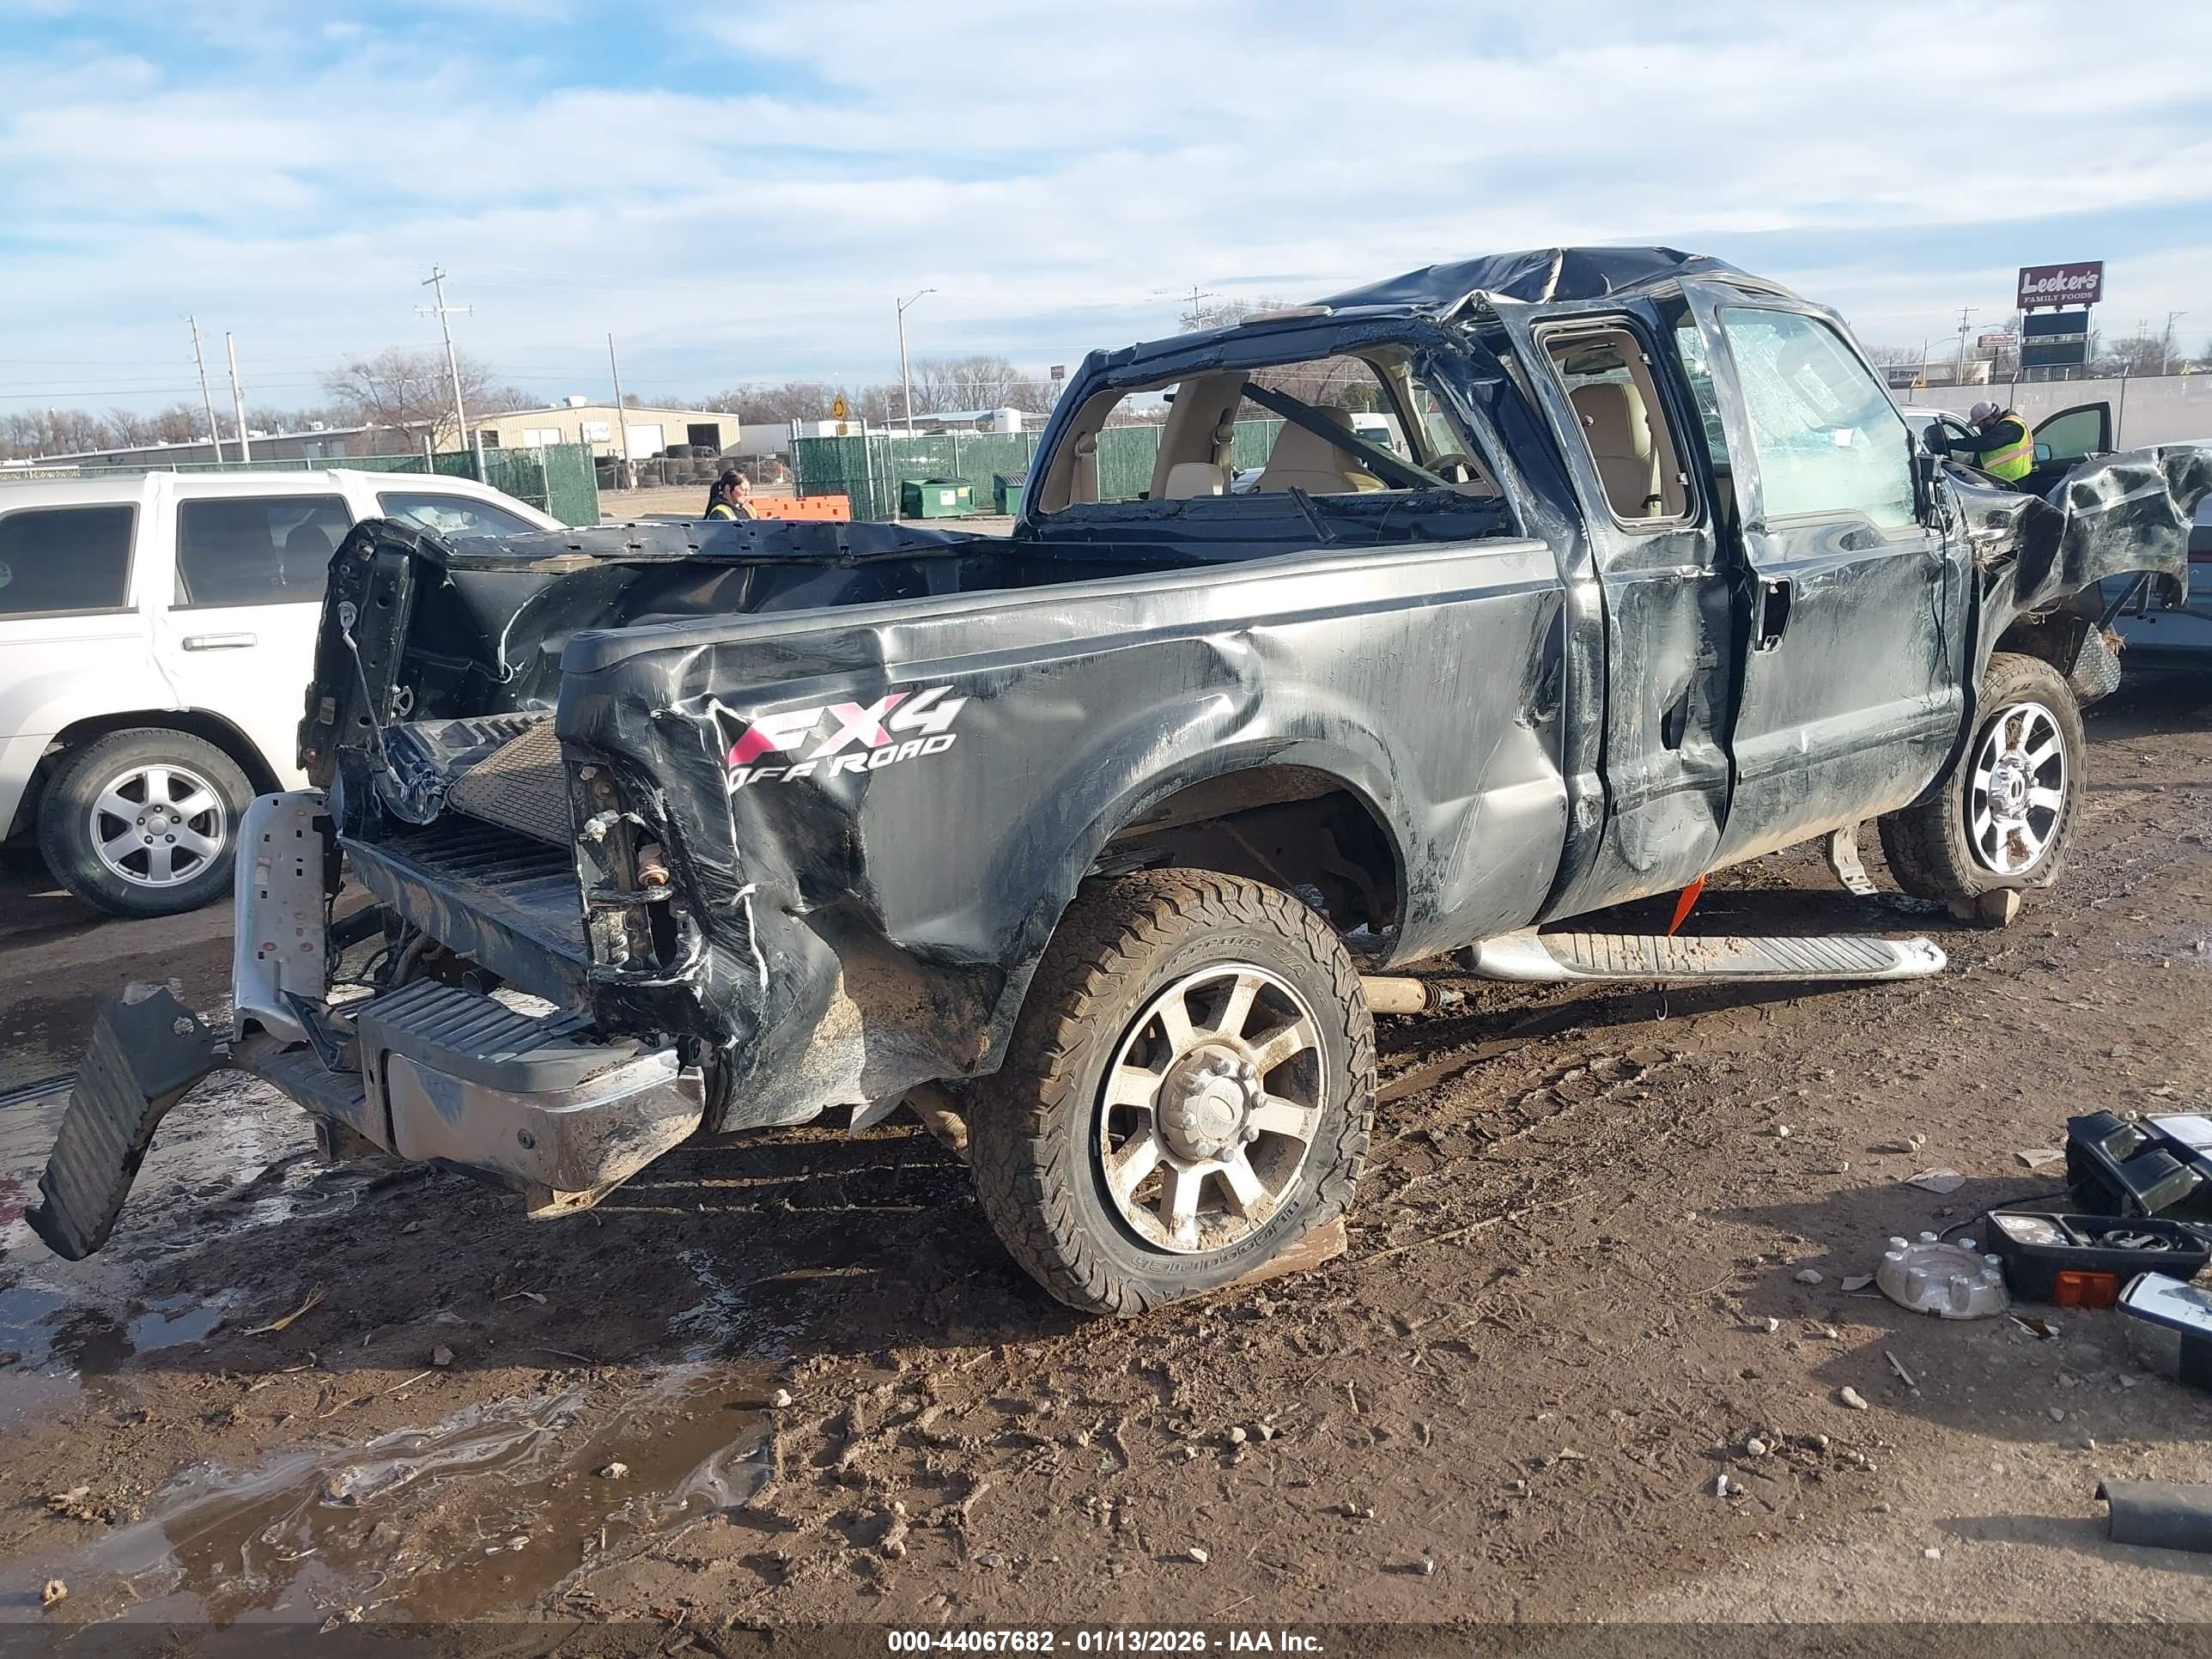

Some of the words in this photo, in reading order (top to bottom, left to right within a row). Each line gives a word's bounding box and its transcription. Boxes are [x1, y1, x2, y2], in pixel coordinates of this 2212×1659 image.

[2021, 270, 2099, 294] Leeker's
[2024, 295, 2058, 303] FAMILY
[2061, 292, 2093, 301] FOODS
[729, 684, 968, 766] FX4
[728, 760, 818, 795] OFF
[827, 732, 957, 778] ROAD
